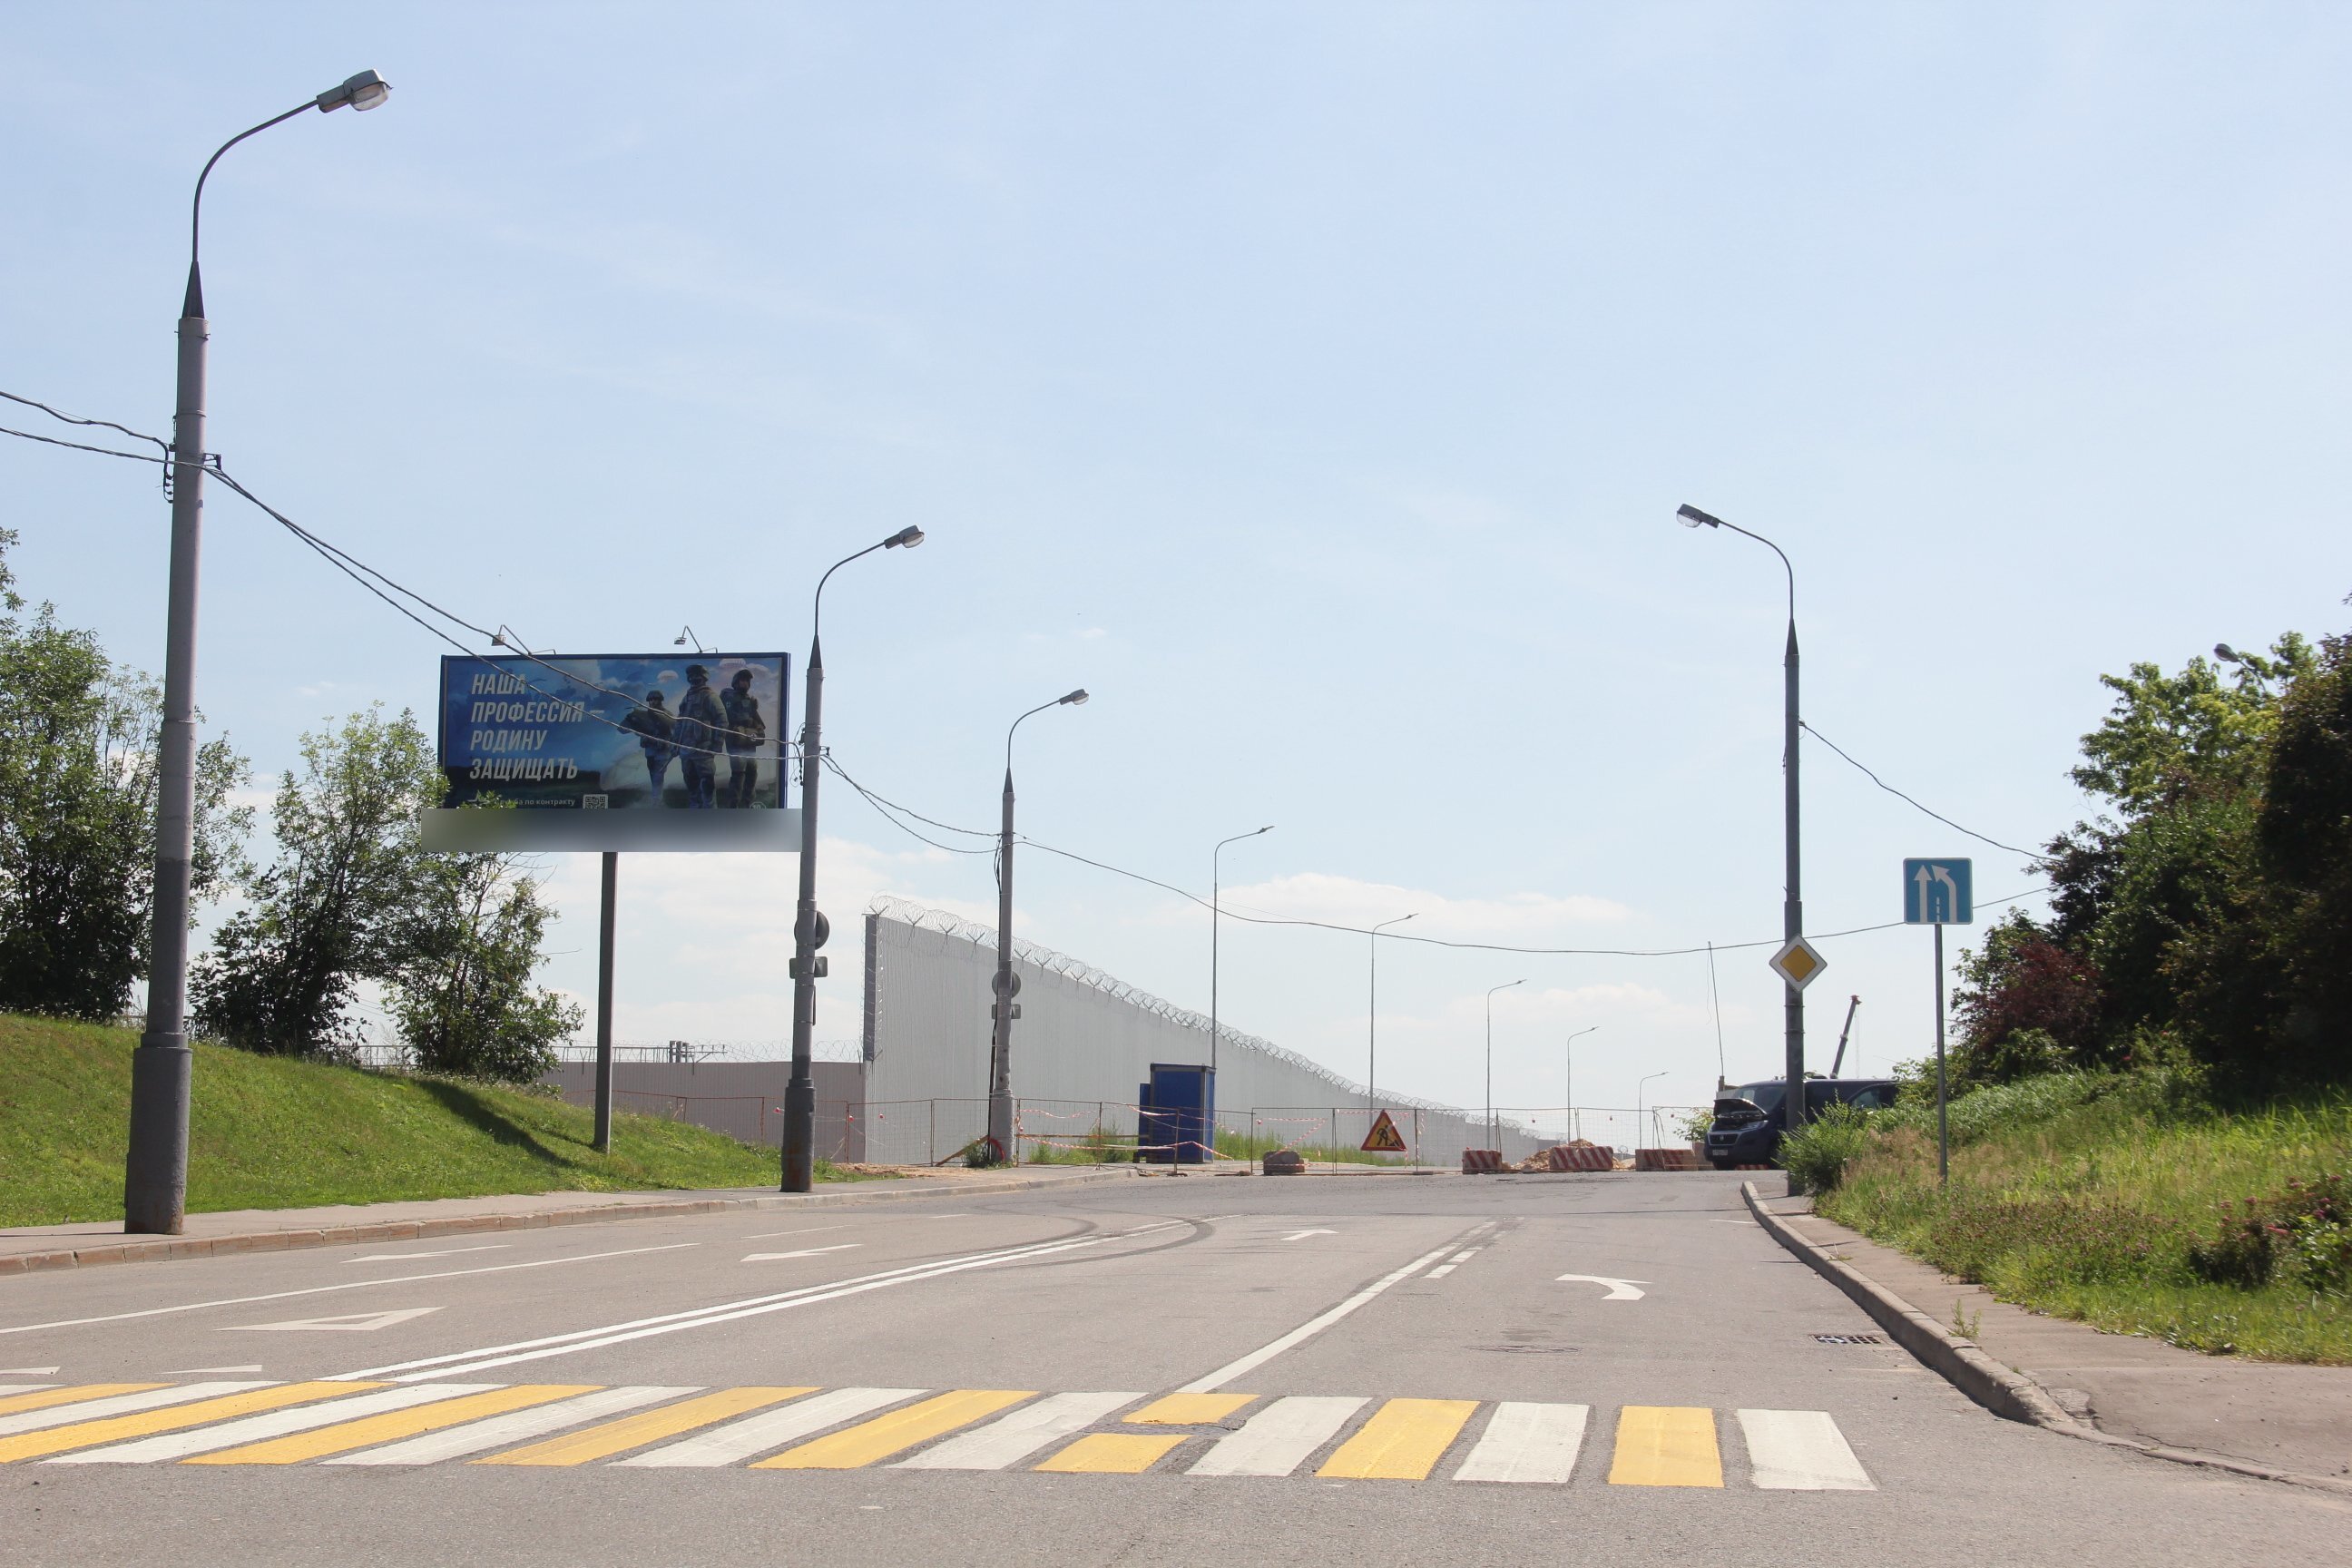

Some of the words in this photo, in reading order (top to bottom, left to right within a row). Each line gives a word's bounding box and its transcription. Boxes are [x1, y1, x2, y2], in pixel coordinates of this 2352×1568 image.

[472, 673, 525, 694] НАША
[471, 701, 585, 722] ПРОФЕССИЯ
[470, 730, 547, 753] РОДИНУ
[470, 758, 577, 781] ЗАЩИЩАТЬ
[535, 799, 575, 807] контракту
